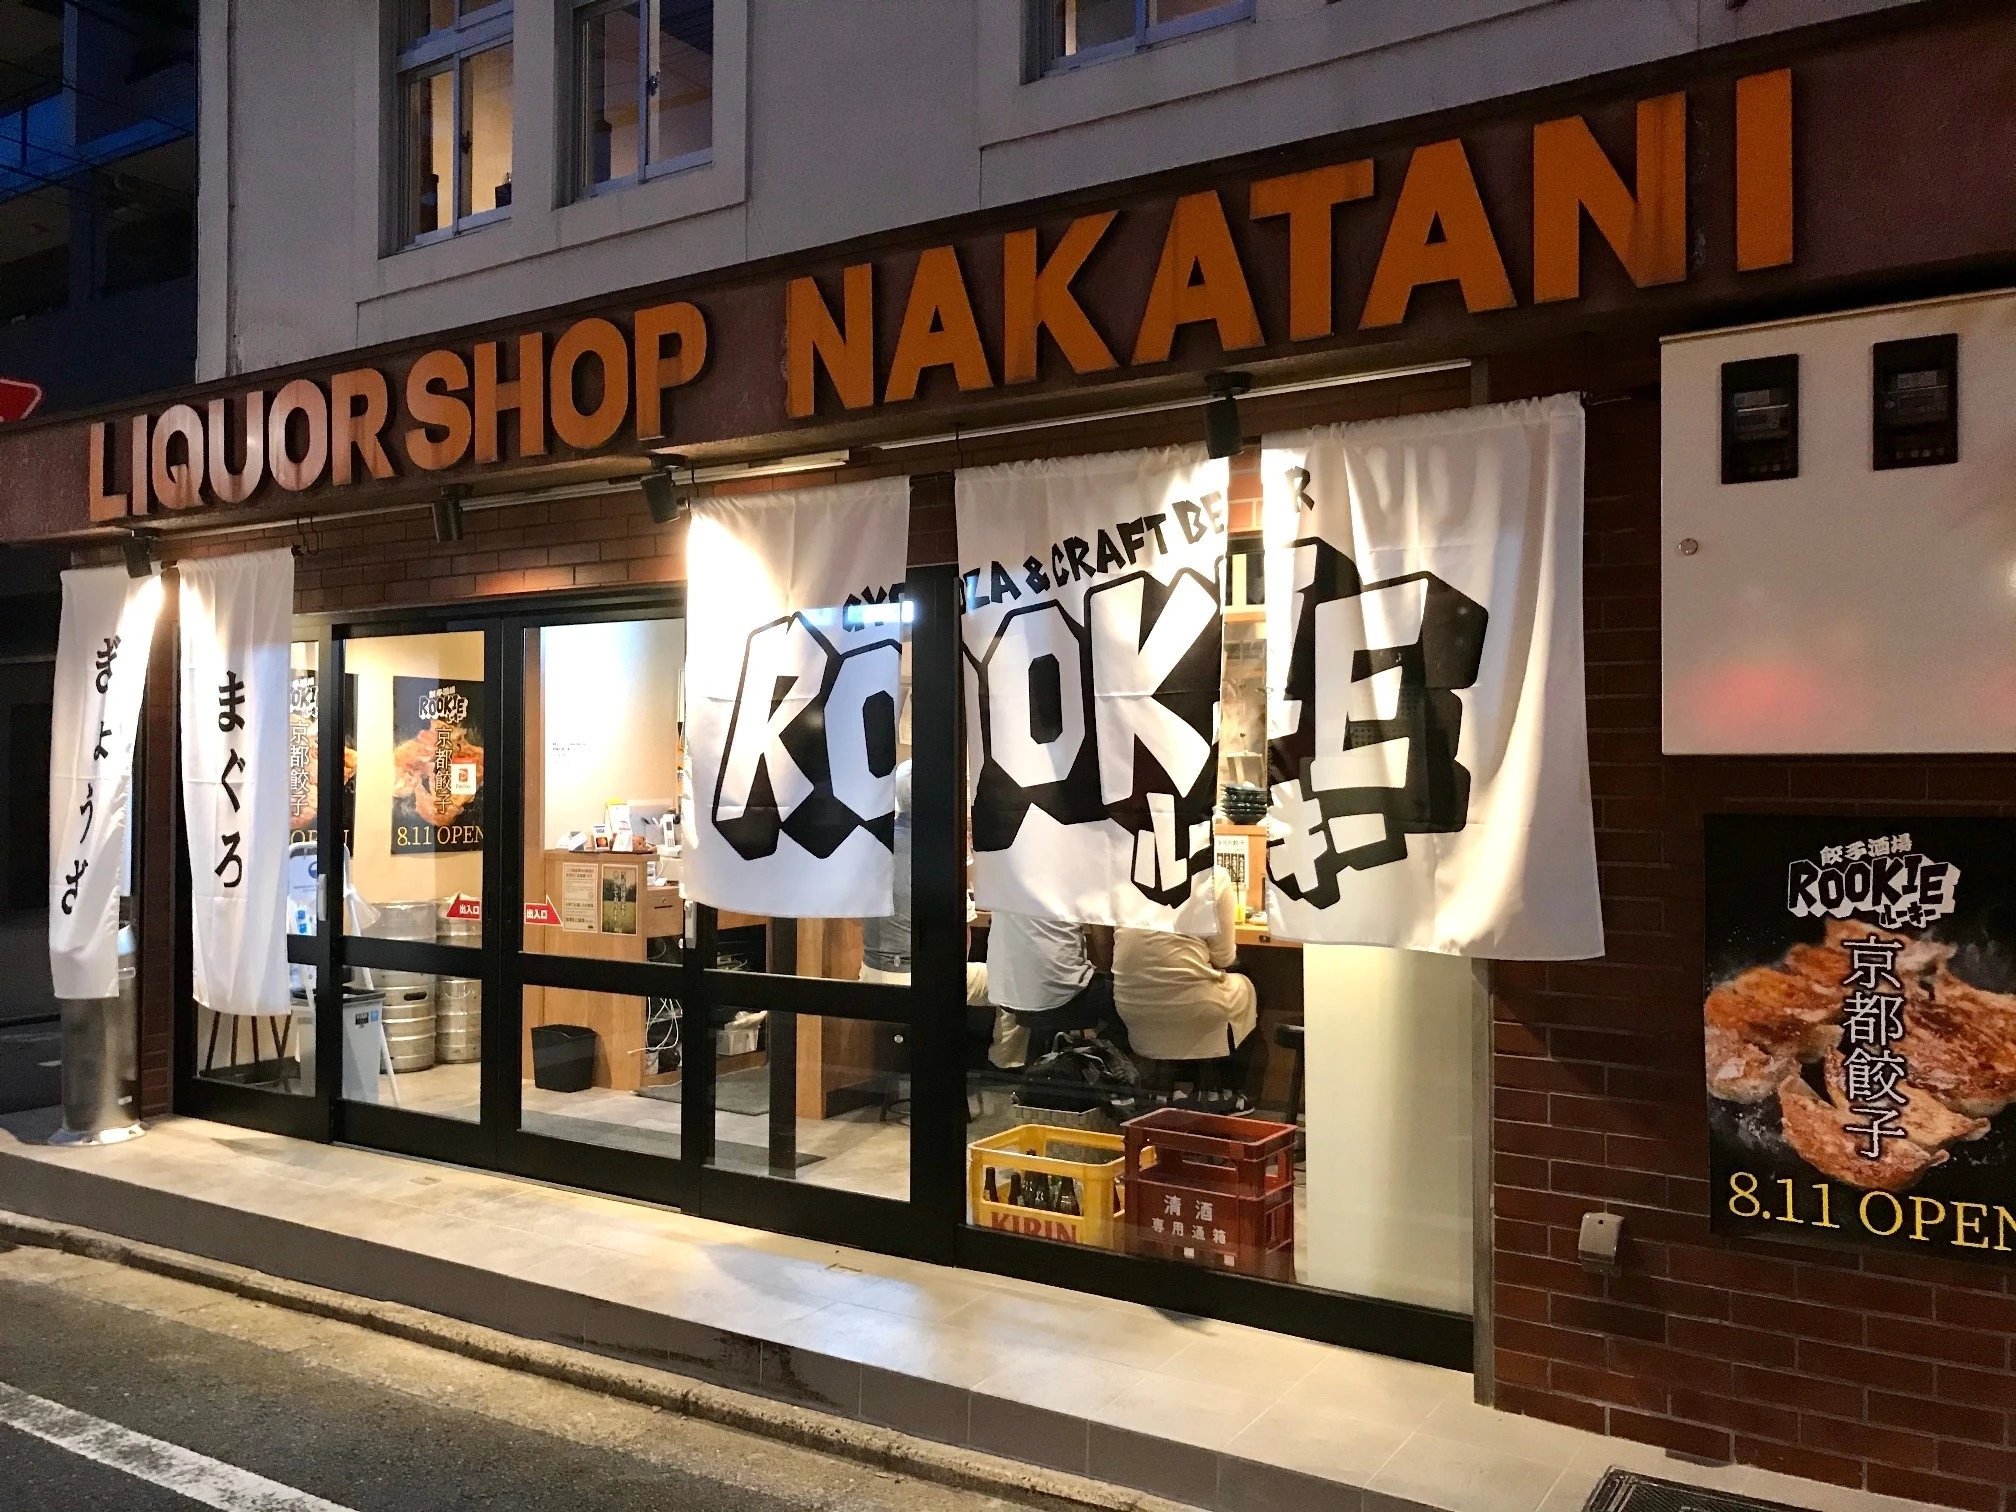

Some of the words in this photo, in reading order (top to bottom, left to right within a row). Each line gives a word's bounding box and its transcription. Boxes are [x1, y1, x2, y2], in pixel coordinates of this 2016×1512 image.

[89, 367, 397, 522] LIQUOR
[405, 302, 707, 470] SHOP
[786, 68, 1793, 419] NAKATANI
[1052, 513, 1169, 587] CRAFT
[1172, 466, 1315, 544] BER
[418, 694, 469, 721] ROOKIE
[61, 635, 121, 915] ぎょうざ
[214, 670, 246, 888] まぐろ
[290, 721, 310, 817] 京都餃子
[434, 725, 453, 815] 京都餃子
[397, 826, 432, 846] 8.11
[1820, 832, 1912, 866] 餃子酒場
[459, 904, 480, 915] 出入口
[526, 908, 548, 920] 出入口
[1788, 853, 1961, 919] ROOKIE
[1842, 935, 1906, 1158] 京都餃子
[990, 1191, 1078, 1244] KIRIN
[1163, 1193, 1214, 1222] 清酒
[1728, 1171, 1841, 1229] 8.11
